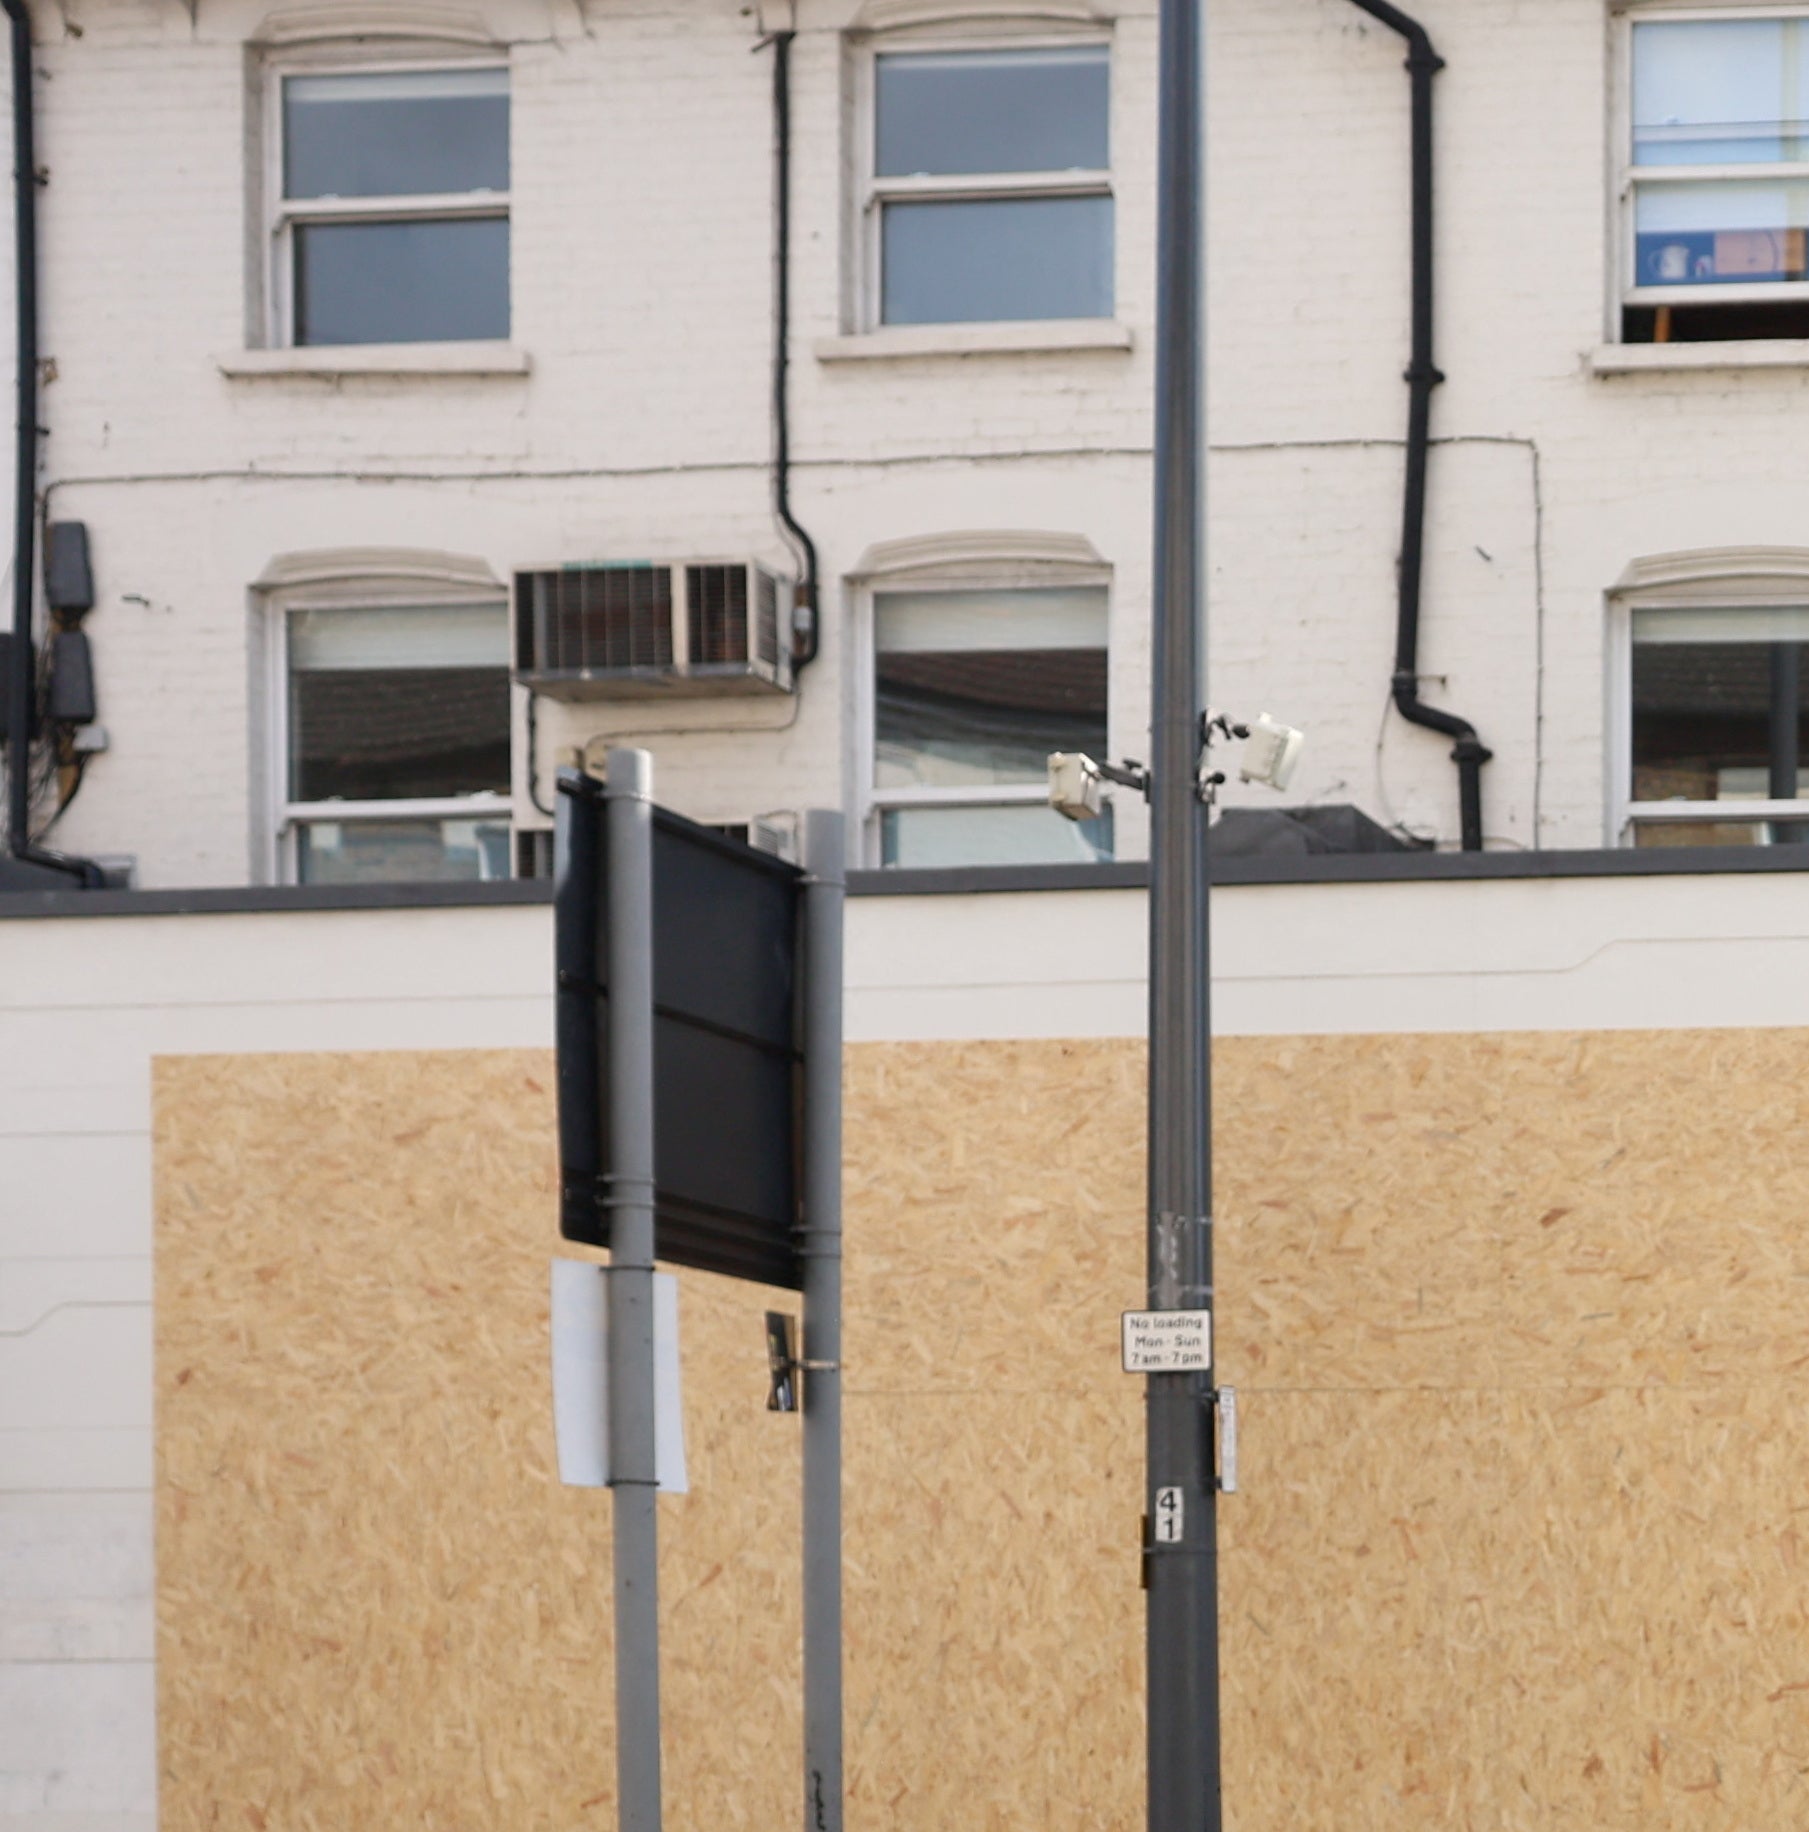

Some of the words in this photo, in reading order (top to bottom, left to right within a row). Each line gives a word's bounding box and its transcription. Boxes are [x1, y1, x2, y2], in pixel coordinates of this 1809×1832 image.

[1130, 1317, 1150, 1330] No
[1152, 1315, 1203, 1330] loading
[1135, 1336, 1163, 1348] Mon
[1173, 1334, 1201, 1347] Sun
